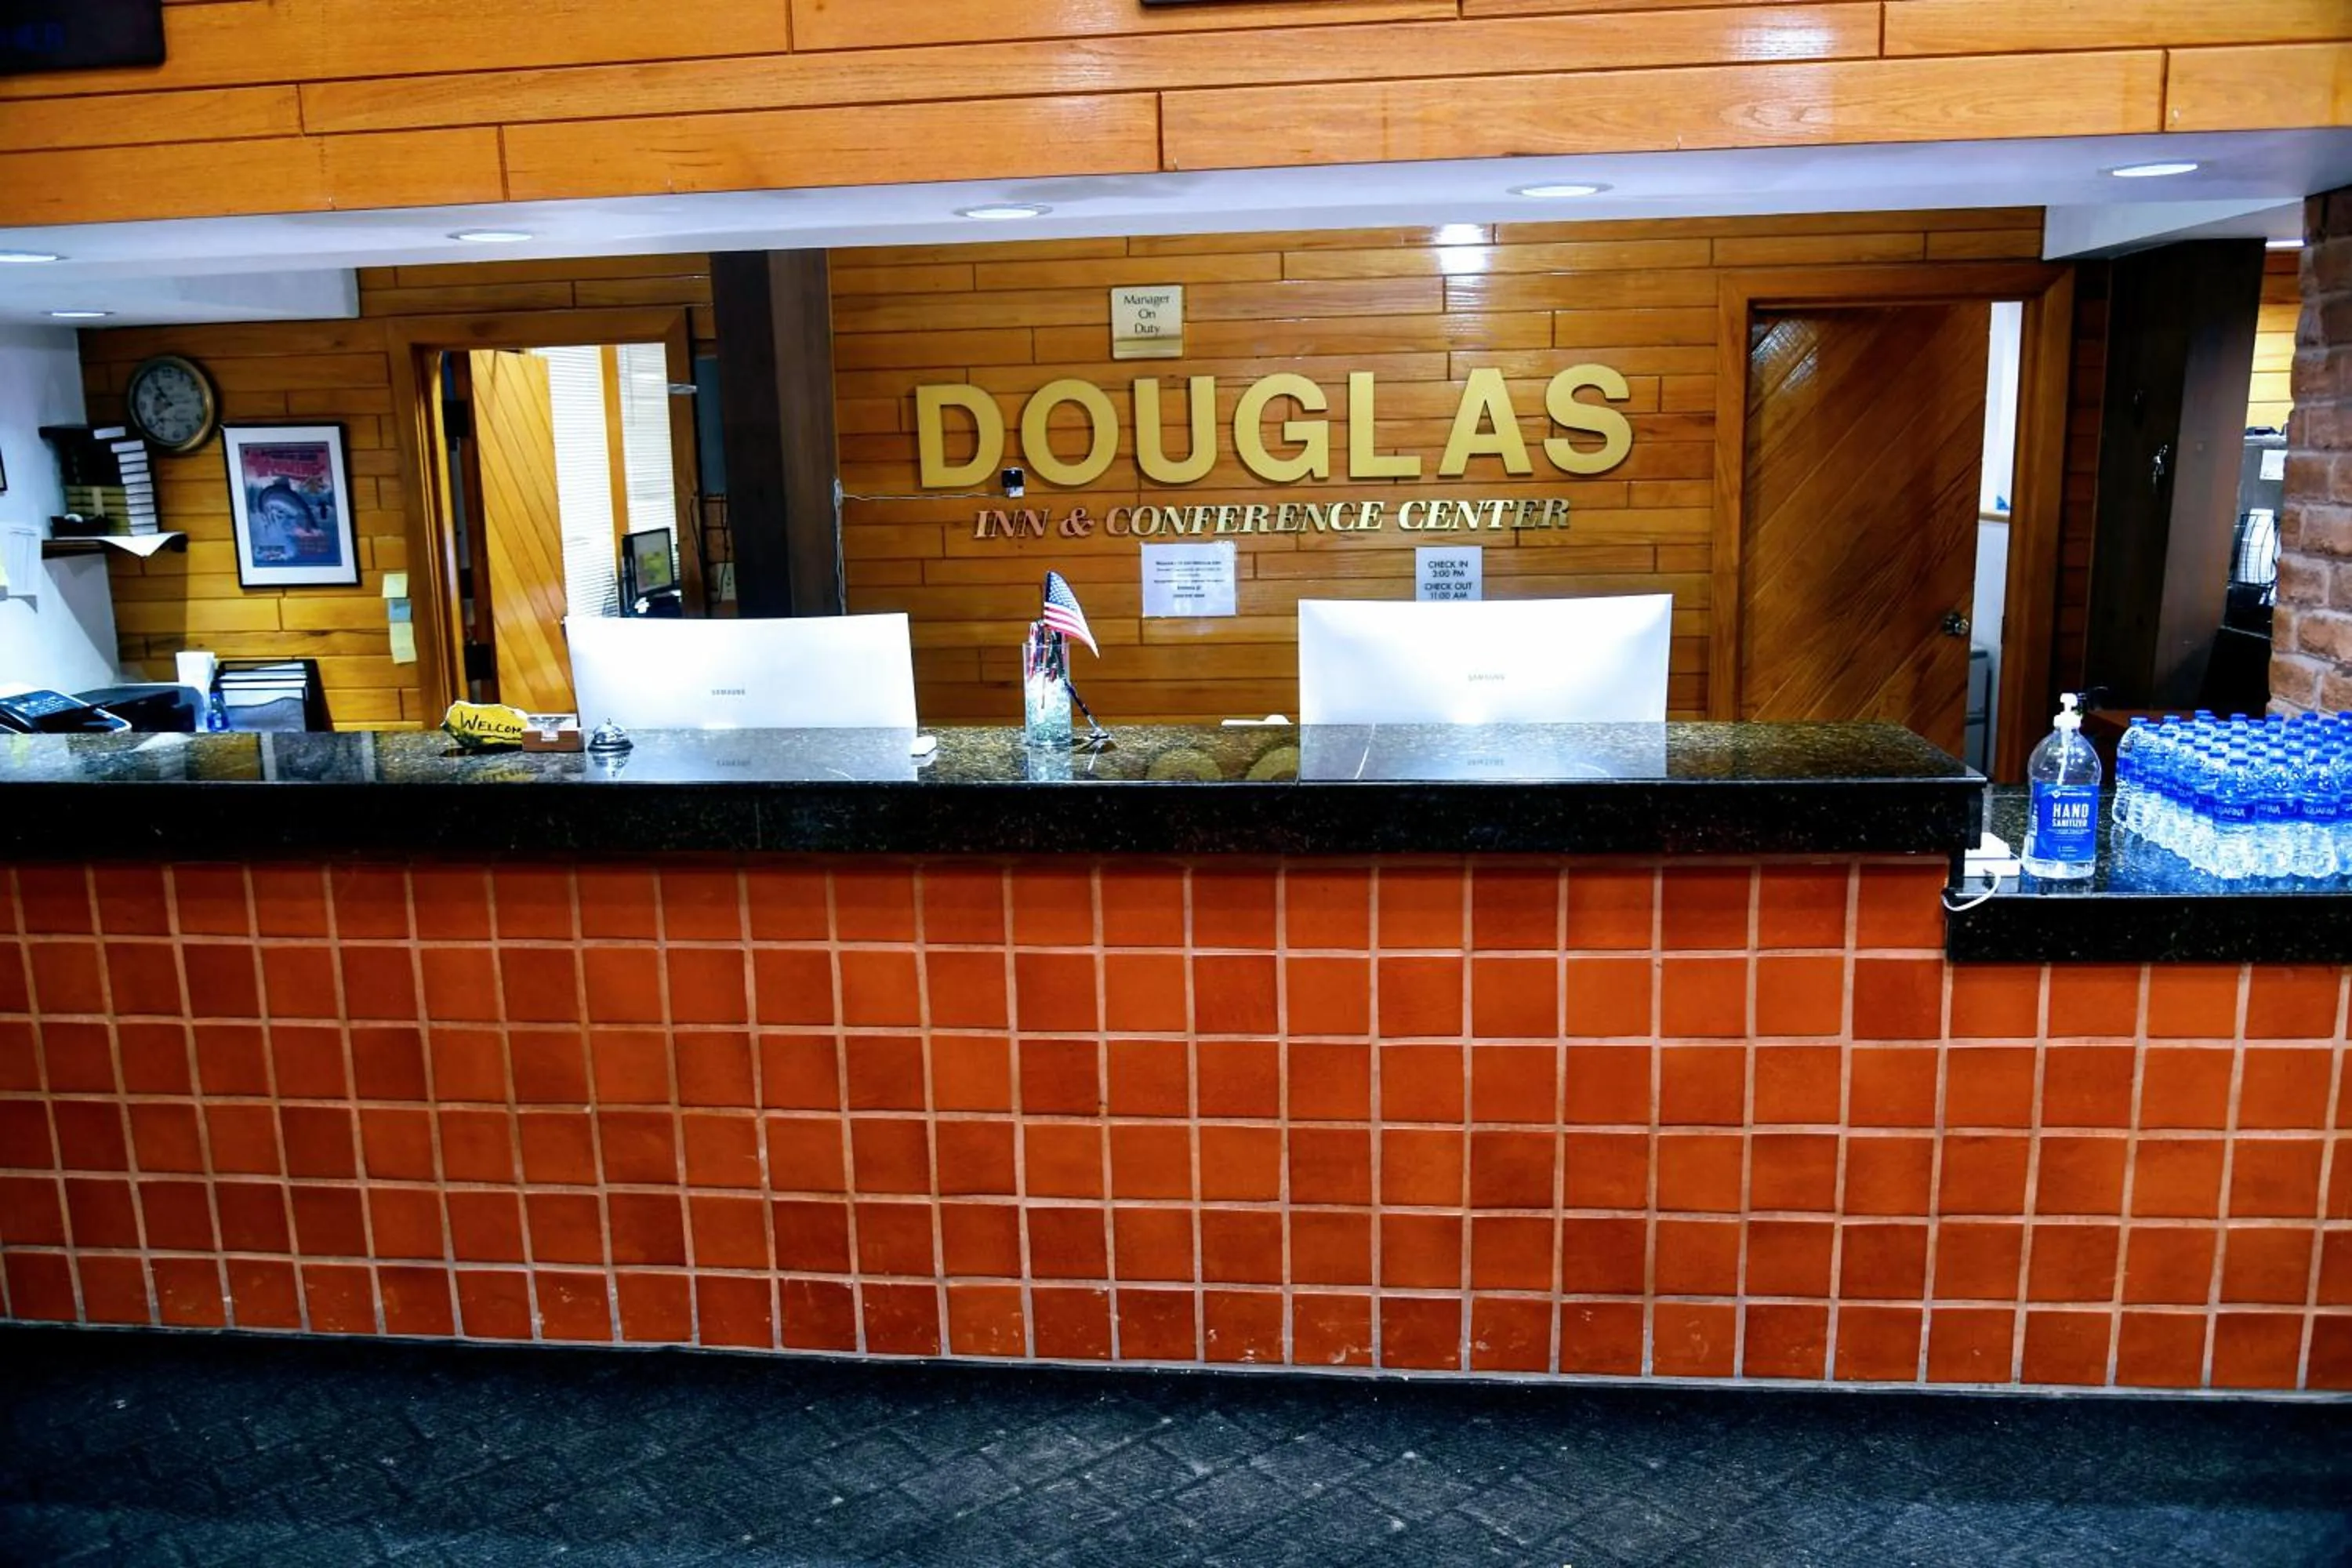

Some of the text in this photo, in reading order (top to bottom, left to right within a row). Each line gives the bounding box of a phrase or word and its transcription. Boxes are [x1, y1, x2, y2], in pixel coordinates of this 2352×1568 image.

[1123, 295, 1170, 307] Manager
[1138, 309, 1156, 319] On
[1134, 323, 1160, 336] Duty
[915, 363, 1632, 489] DOUGLAS
[973, 499, 1569, 539] INN & CONFERENCE CENTER
[1428, 560, 1456, 568] CHECK
[1453, 569, 1465, 578] PM
[1454, 582, 1472, 590] OUT
[1453, 591, 1468, 600] AM
[460, 711, 521, 735] WELCOM
[2053, 802, 2089, 818] HAND
